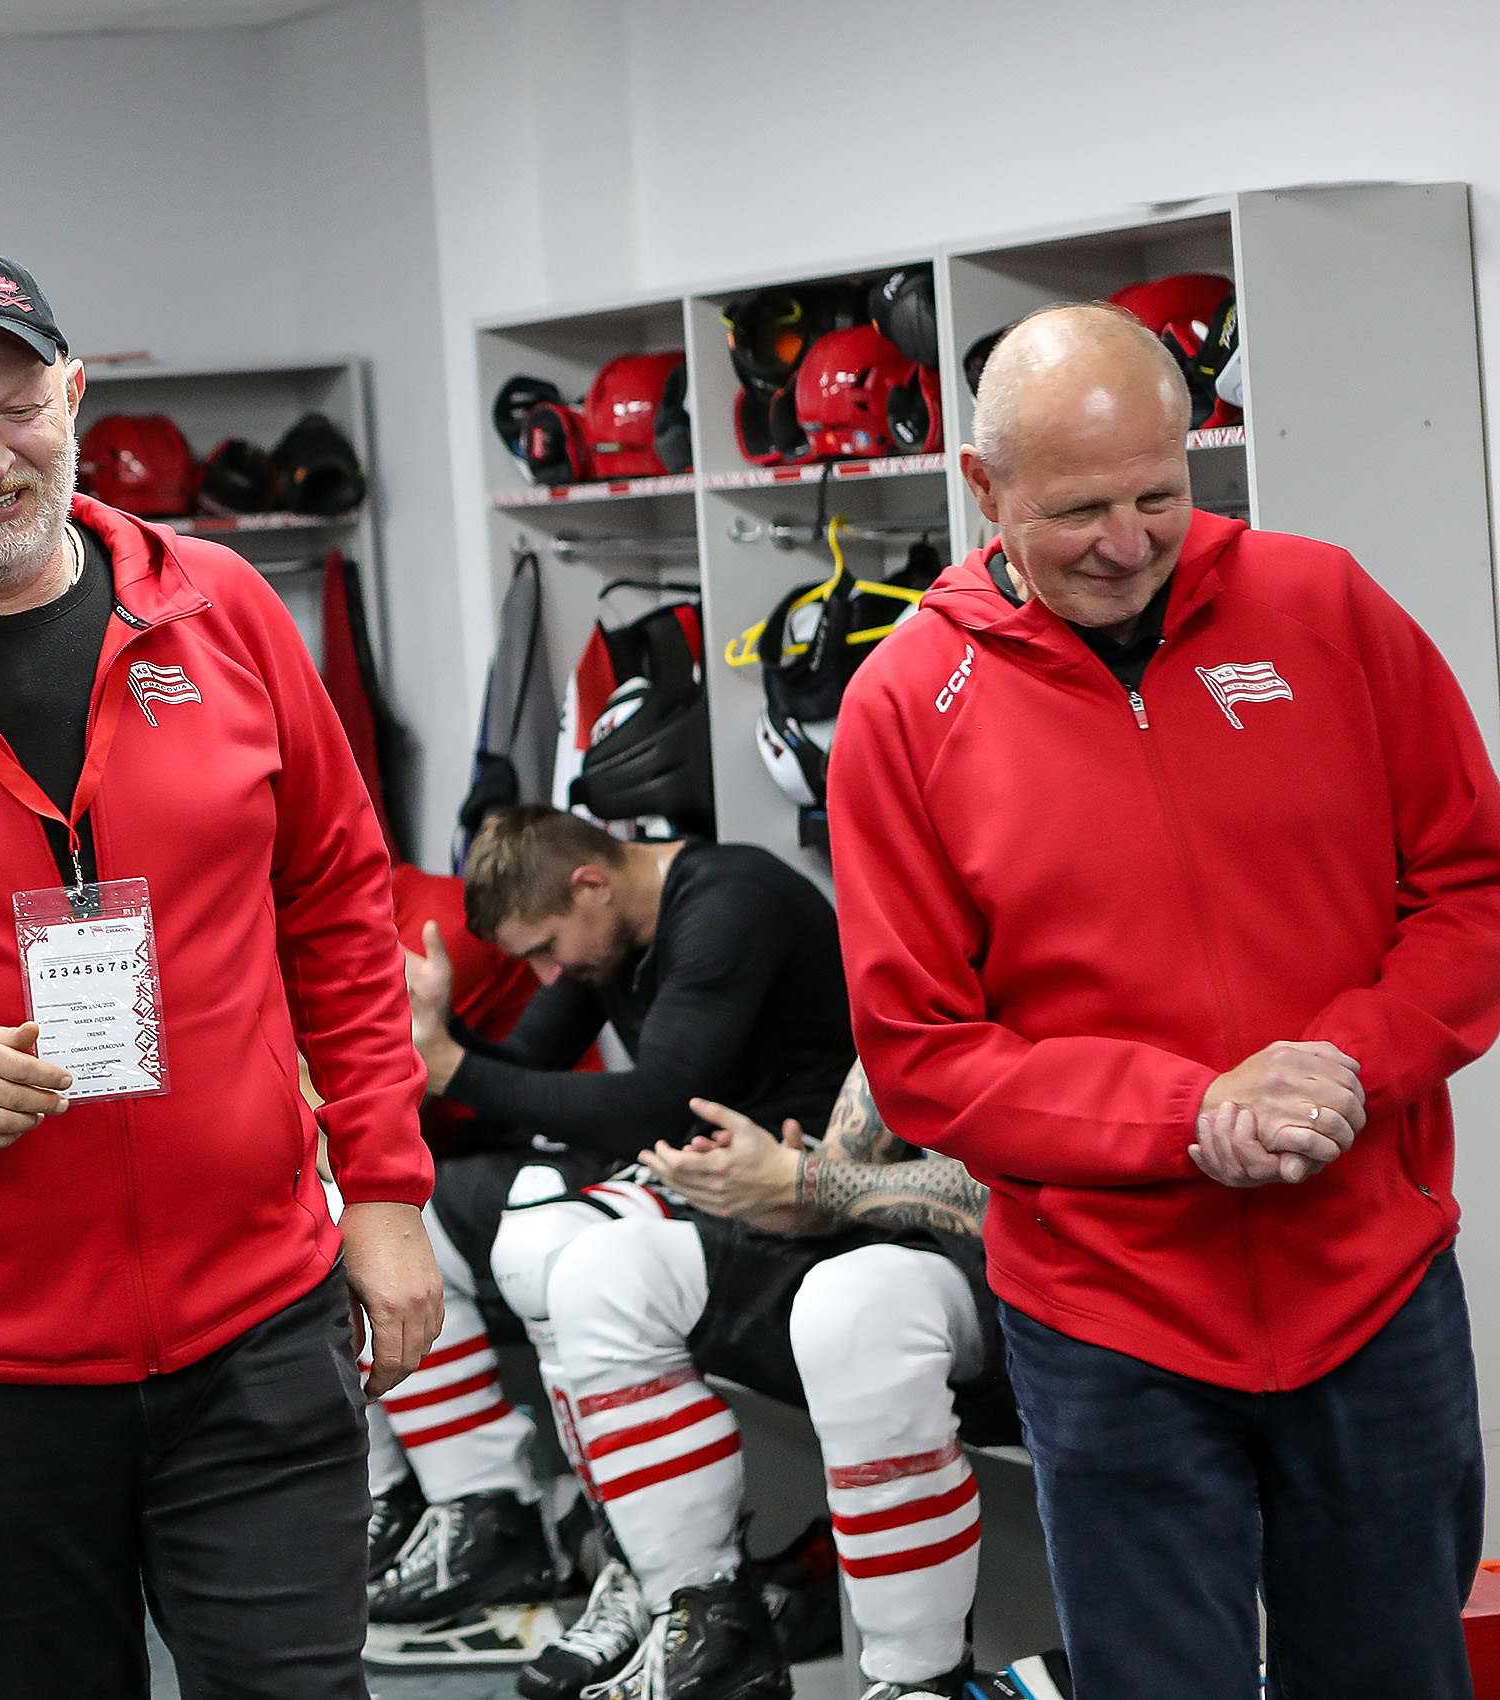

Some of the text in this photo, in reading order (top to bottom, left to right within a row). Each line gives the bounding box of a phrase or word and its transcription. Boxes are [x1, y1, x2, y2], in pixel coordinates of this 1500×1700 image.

[934, 643, 975, 713] CCM
[1217, 670, 1233, 679] KS
[143, 682, 188, 692] CRACOVIA
[1226, 680, 1278, 690] CRACOVIA
